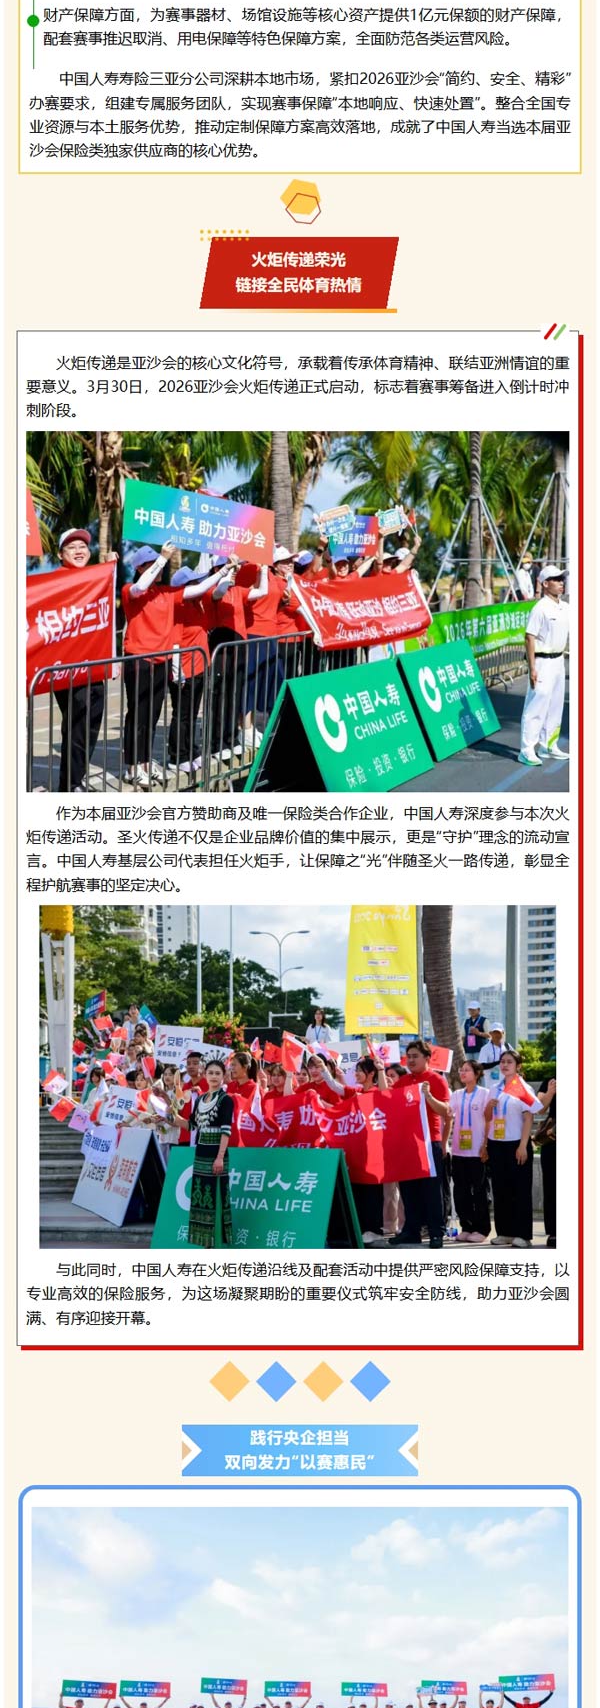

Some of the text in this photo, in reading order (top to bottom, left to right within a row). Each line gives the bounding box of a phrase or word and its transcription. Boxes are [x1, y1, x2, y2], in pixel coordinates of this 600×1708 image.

[43, 7, 561, 23] 财产保障方面，为赛事器材、场馆设施等核心资产提供1亿元保额的财产保障，
[44, 30, 510, 47] 配套赛事推迟取消、用电保障等特色保障方案，全面防范各类运营风险。
[29, 119, 571, 135] 业资源与本土服务优势，推动定制保障方案高效落地，成就了中国人寿当选本届亚
[30, 143, 259, 159] 沙会保险类独家供应商的核心优势。
[252, 252, 346, 268] 火炬传递荣光
[235, 277, 362, 293] 链接全民体育热情
[56, 355, 571, 371] 火炬传递是亚沙会的核心文化符号，承载着传承体育精神、联结亚洲情谊的重
[26, 379, 570, 395] 要意义。3月30日，2026亚沙会火炬传递正式启动，标志着赛事筹备进入倒计时冲
[27, 402, 78, 418] 刺阶段。
[134, 507, 267, 549] 中国人寿 助力亚沙会
[35, 596, 111, 646] 相约三亚
[435, 659, 475, 689] 中国人寿
[445, 681, 481, 704] CHINA LIFE
[343, 682, 401, 721] 中国人寿
[353, 710, 408, 740] CHINA LIFE
[56, 805, 570, 821] 作为本届亚沙会官方赞助商及唯一保险类合作企业，中国人寿深度参与本次火
[26, 877, 182, 893] 程护航赛事的坚定决心。
[274, 1199, 313, 1213] LIFE
[56, 1262, 570, 1278] 与此同时，中国人寿在火炬传递沿线及配套活动中提供严密风险保障支持，以
[26, 1285, 570, 1301] 专业高效的保险服务，为这场凝聚期盼的重要仪式筑牢安全防线，助力亚沙会圆
[26, 1310, 152, 1326] 满、有序迎接开幕。
[250, 1429, 349, 1446] 践行央企担当
